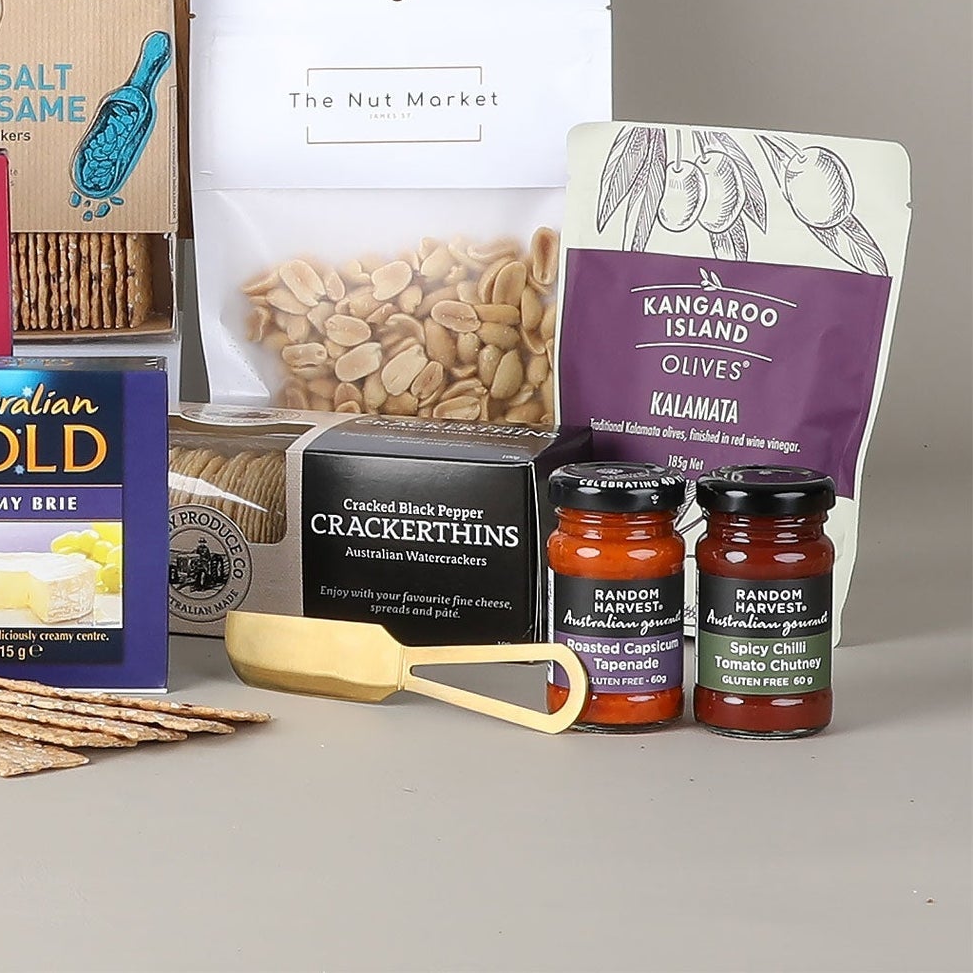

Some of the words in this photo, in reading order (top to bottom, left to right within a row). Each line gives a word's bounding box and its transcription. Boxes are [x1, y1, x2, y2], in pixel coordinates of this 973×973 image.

[289, 93, 333, 108] The
[349, 92, 391, 107] Nut
[407, 92, 498, 106] Market
[644, 296, 778, 327] KANGAROO
[667, 318, 748, 343] ISLAND
[651, 392, 739, 424] KALAMATA
[625, 422, 660, 437] Kalamata
[663, 426, 687, 441] olives,
[690, 428, 720, 443] finished
[721, 433, 729, 444] in
[731, 433, 744, 446] red
[746, 437, 765, 448] wine
[767, 438, 800, 453] vinegar.
[668, 455, 688, 471] 185g
[690, 458, 703, 470] Net
[580, 479, 659, 488] CELEBRATING
[32, 496, 77, 510] BRIE
[343, 499, 395, 513] Cracked
[399, 502, 434, 516] Black
[438, 505, 484, 520] Pepper
[179, 511, 242, 555] PRODUCE
[311, 513, 519, 547] CRACKERTHINS
[345, 547, 403, 561] Australian
[406, 551, 487, 566] Watercrackers
[214, 590, 238, 612] MADE
[320, 586, 349, 598] Enjoy
[351, 589, 374, 599] with
[376, 593, 401, 601] your
[402, 592, 450, 606] favourite
[452, 596, 472, 607] fine
[475, 598, 512, 610] cheese,
[595, 589, 659, 600] RANDOM
[737, 589, 802, 601] RANDOM
[370, 604, 410, 615] spreads
[412, 607, 432, 616] and
[563, 610, 639, 628] Australian
[707, 609, 780, 629] Australian
[39, 633, 73, 642] creamy
[77, 631, 109, 641] centre.
[18, 648, 26, 659] g
[567, 639, 620, 654] Roasted
[624, 639, 679, 655] Capsicum
[730, 642, 769, 657] Spicy
[773, 641, 806, 655] Chilli
[594, 658, 659, 672] Tapenade
[715, 656, 766, 671] Tomato
[770, 657, 821, 671] Chutney
[622, 677, 643, 685] FREE
[722, 675, 760, 686] GLUTEN
[763, 678, 789, 686] FREE
